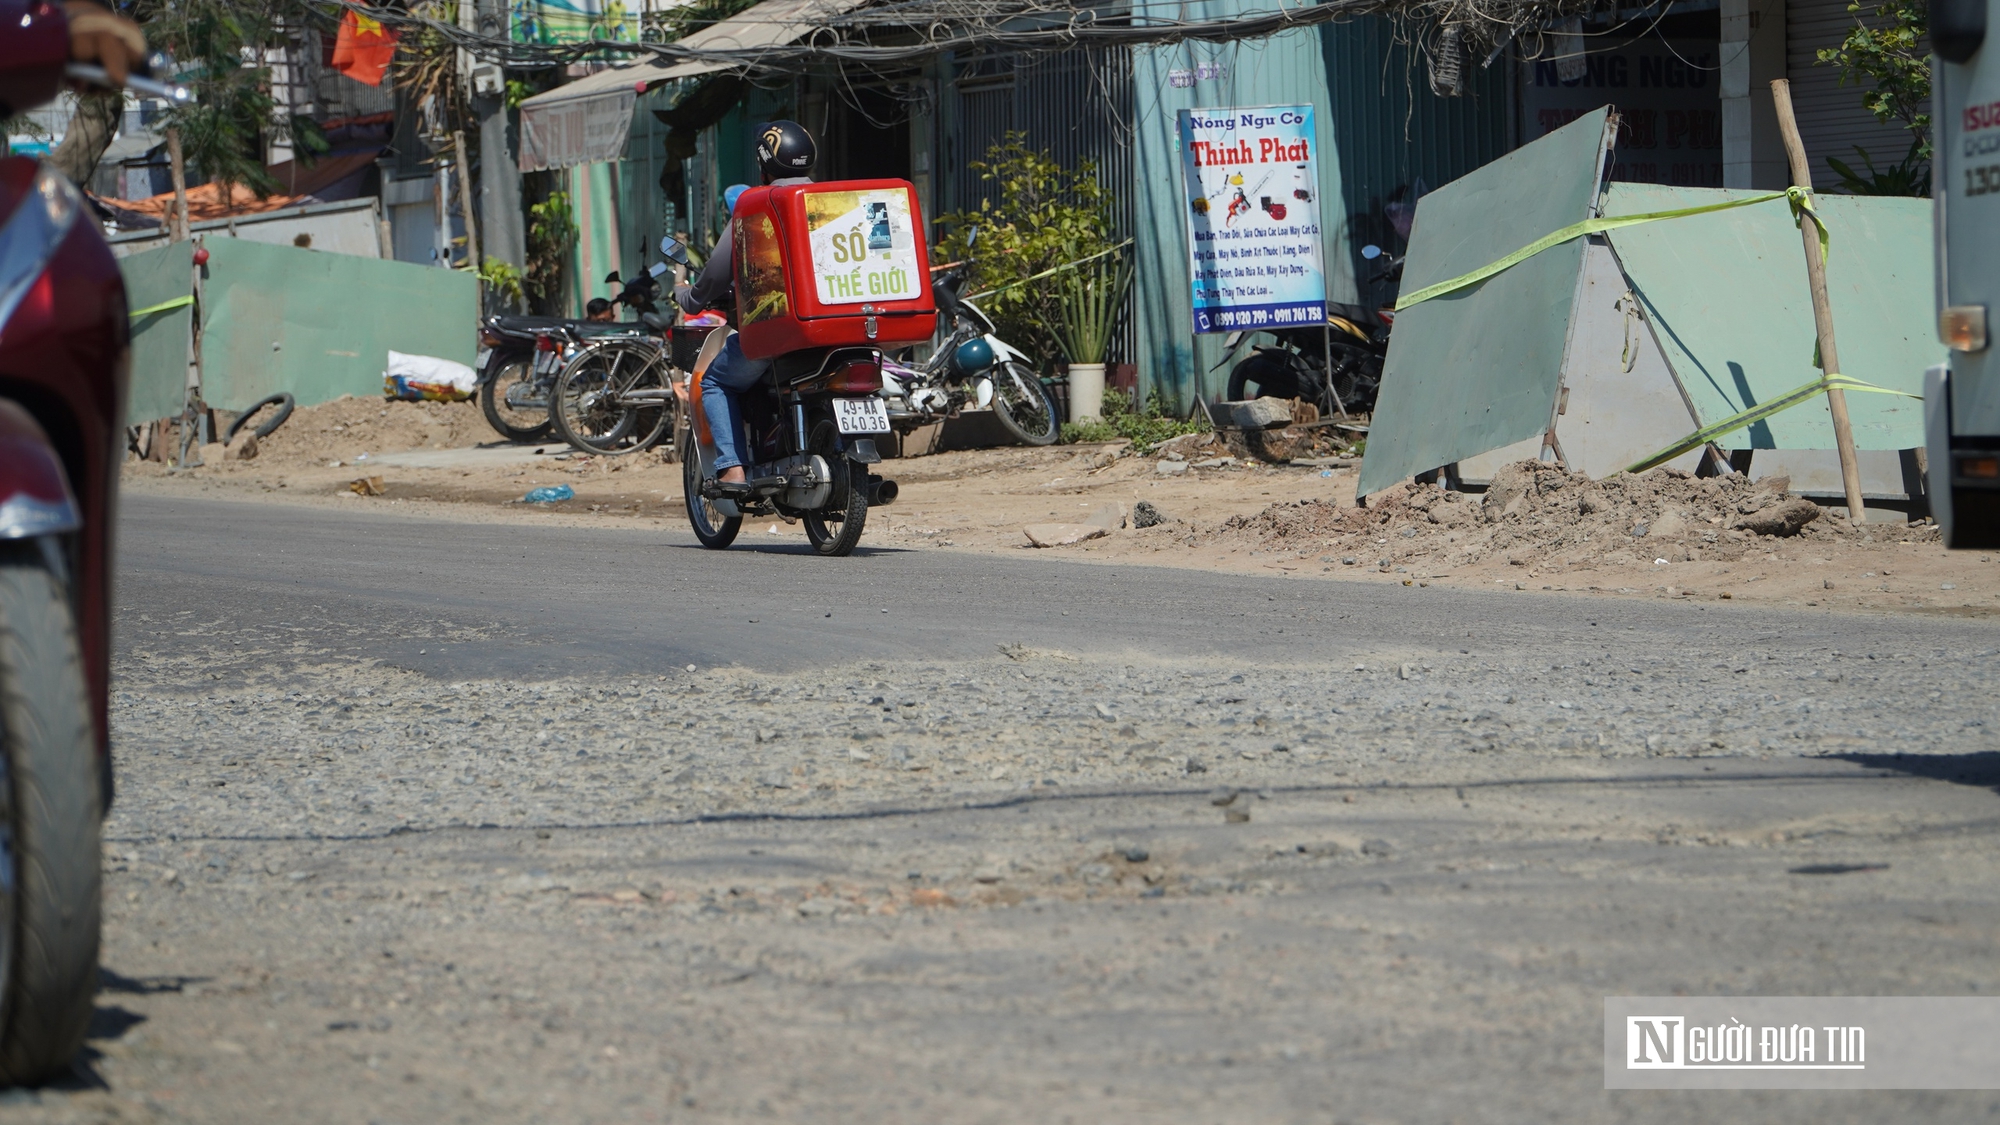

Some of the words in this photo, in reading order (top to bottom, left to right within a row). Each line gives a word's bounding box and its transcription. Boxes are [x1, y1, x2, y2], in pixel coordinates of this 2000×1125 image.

[1190, 116, 1235, 130] Nông
[1240, 114, 1275, 129] Ngư
[1280, 112, 1304, 124] Cơ
[1190, 139, 1253, 171] Thịnh
[1259, 137, 1309, 163] Phát
[832, 222, 866, 263] SỐ
[824, 266, 864, 298] THẾ
[868, 266, 908, 295] GIỚI
[1214, 312, 1234, 327] 0399
[1235, 310, 1251, 325] 920
[1252, 309, 1267, 324] 799
[1274, 308, 1291, 323] 0911
[1292, 307, 1306, 322] 761
[1306, 306, 1322, 320] 758
[843, 400, 878, 415] 49-AA
[841, 416, 887, 431] 640.36
